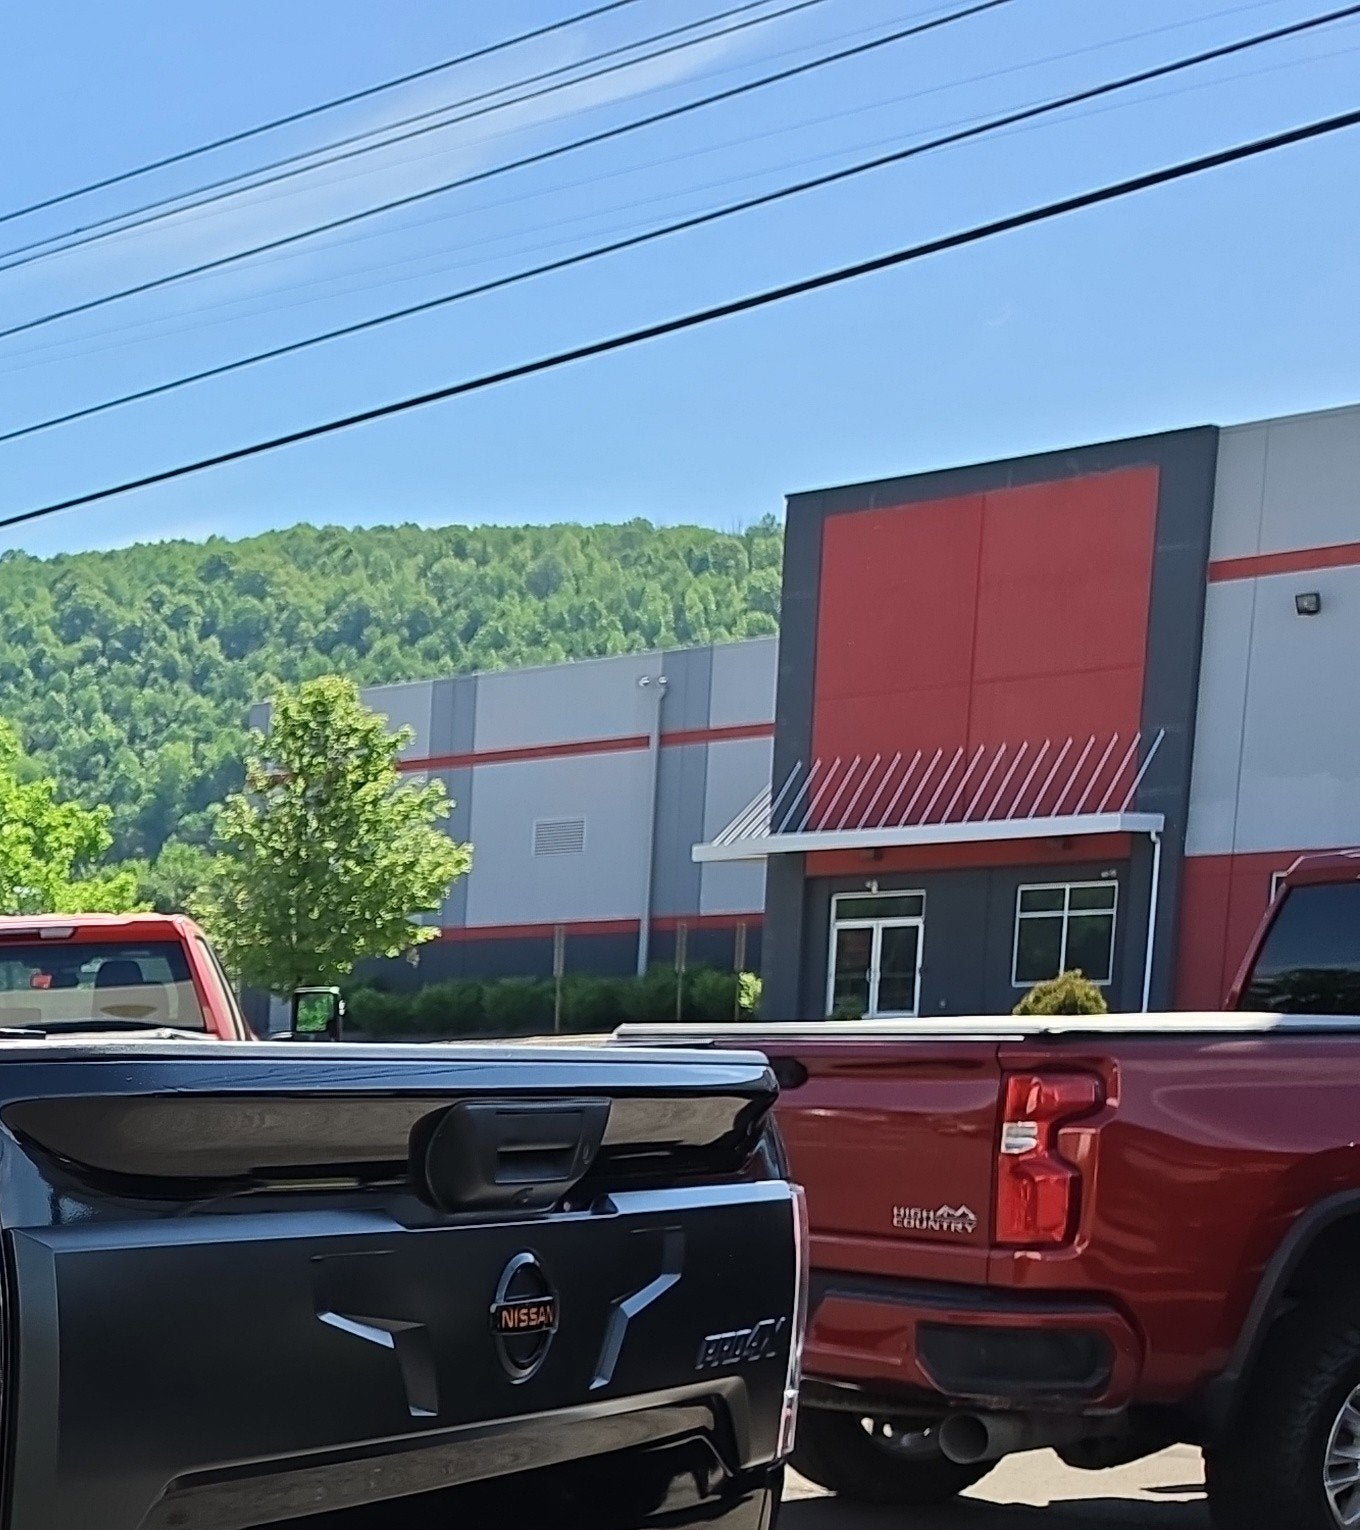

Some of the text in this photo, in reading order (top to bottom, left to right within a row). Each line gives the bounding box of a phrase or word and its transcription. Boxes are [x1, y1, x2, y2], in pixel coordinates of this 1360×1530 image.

[892, 1205, 935, 1220] HIGH
[892, 1216, 978, 1234] COUNTRY
[501, 1304, 554, 1329] NISSAN
